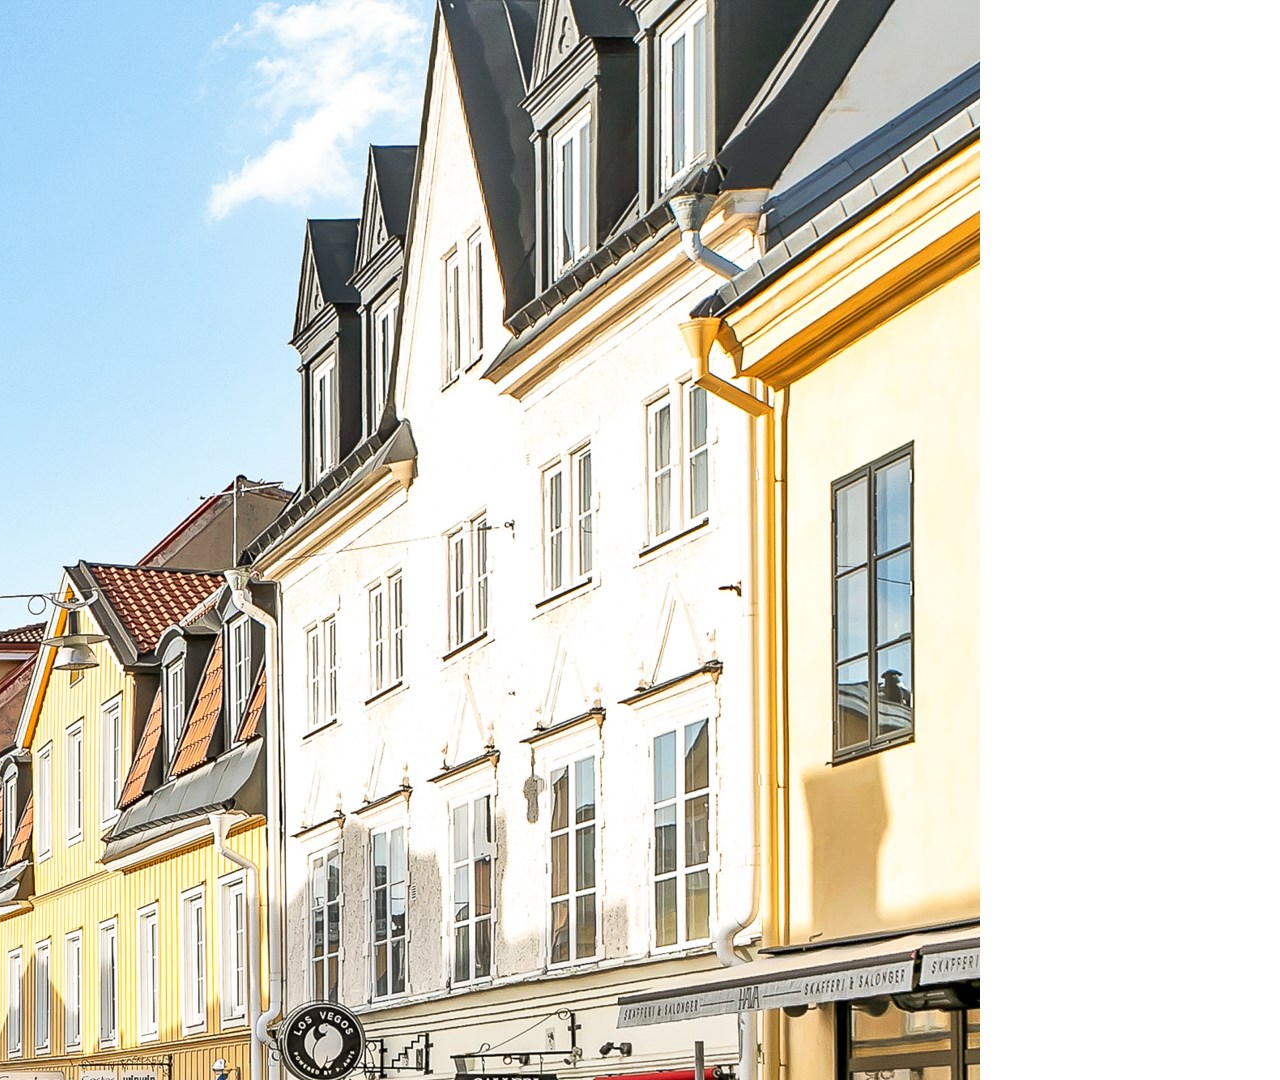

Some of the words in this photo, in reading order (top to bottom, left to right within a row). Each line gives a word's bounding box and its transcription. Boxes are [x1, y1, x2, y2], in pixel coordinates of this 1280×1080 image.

[804, 981, 845, 996] SKAFFERI
[859, 969, 905, 988] SALONGER
[623, 1006, 655, 1021] SKAFFERI
[664, 1000, 698, 1016] SALONGER
[293, 1015, 313, 1036] LOS
[319, 1011, 354, 1035] VEGOS
[293, 1051, 320, 1075] POWERED
